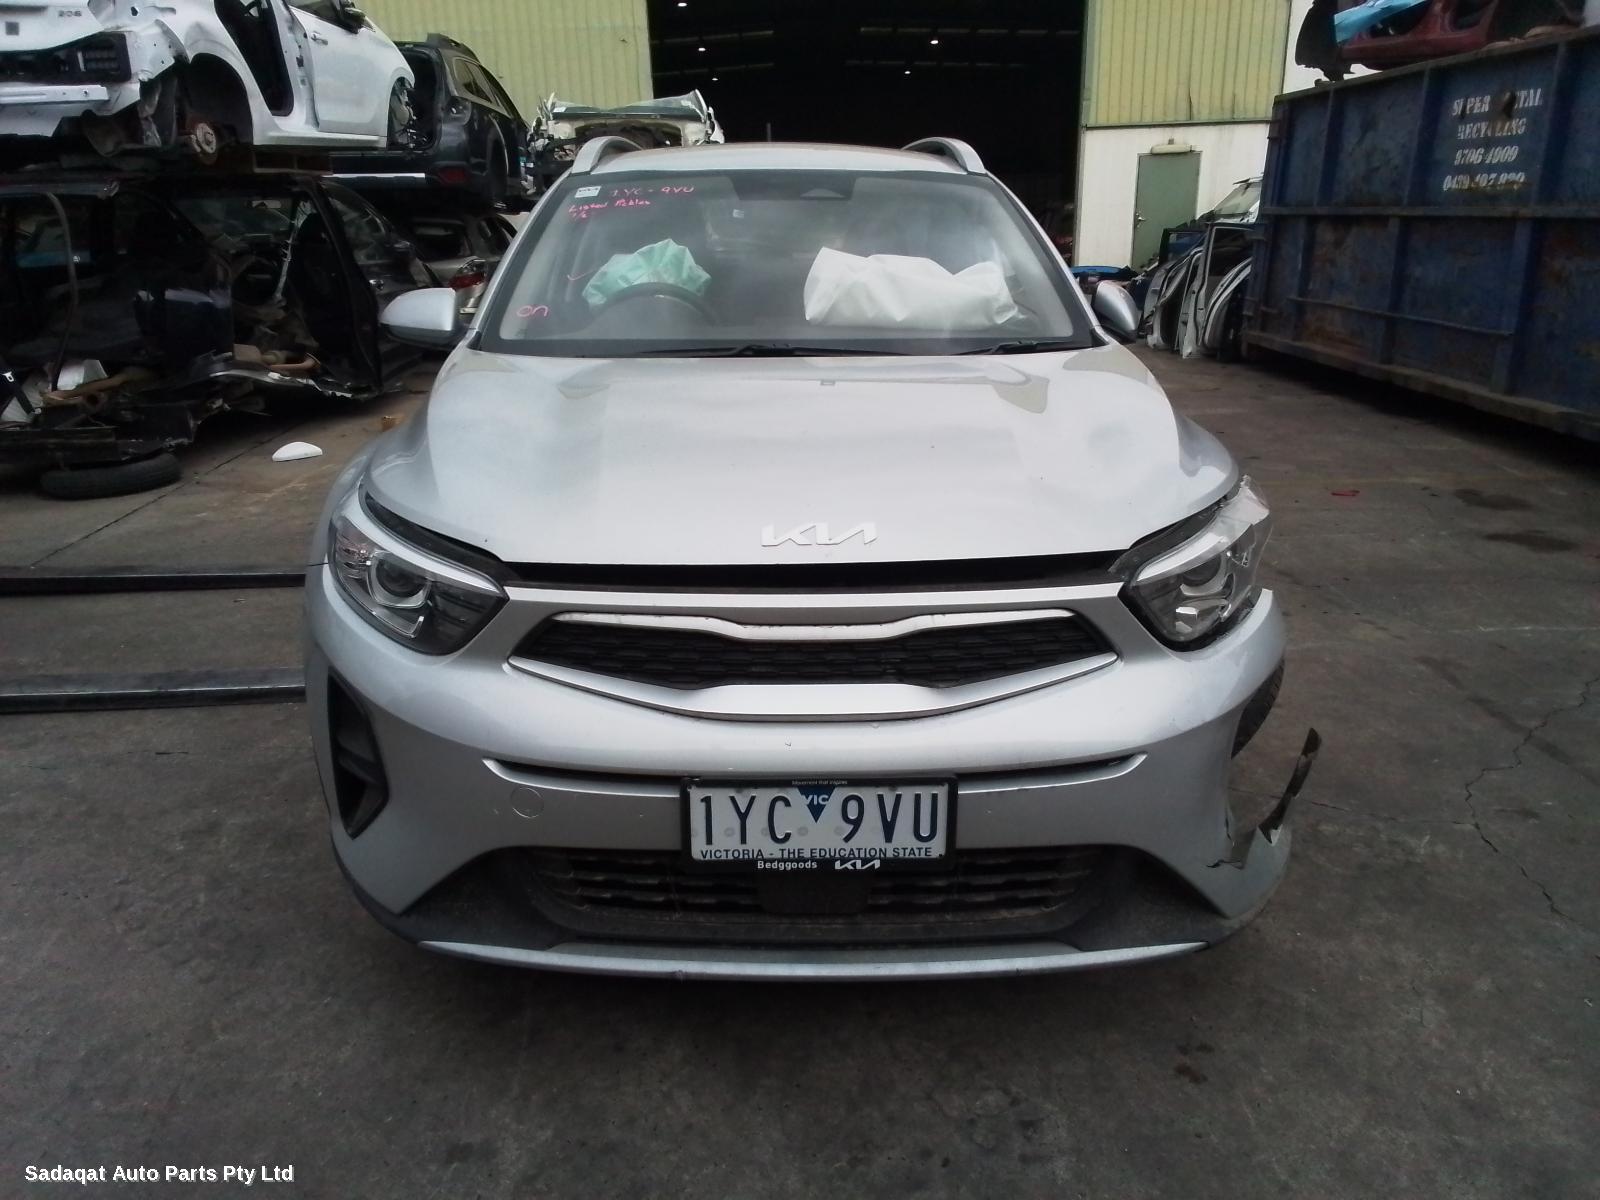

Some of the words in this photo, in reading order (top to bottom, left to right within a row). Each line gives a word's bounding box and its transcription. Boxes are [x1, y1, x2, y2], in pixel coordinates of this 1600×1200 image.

[761, 521, 877, 547] KIA
[801, 793, 829, 806] VIC
[699, 794, 792, 846] 1YC
[840, 792, 939, 844] 9VU
[700, 849, 764, 860] VICTORIA
[779, 848, 805, 859] THE
[809, 848, 888, 859] EDUCATION
[891, 847, 933, 858] STATE
[756, 860, 818, 870] Bedggoods
[834, 859, 881, 870] KIA
